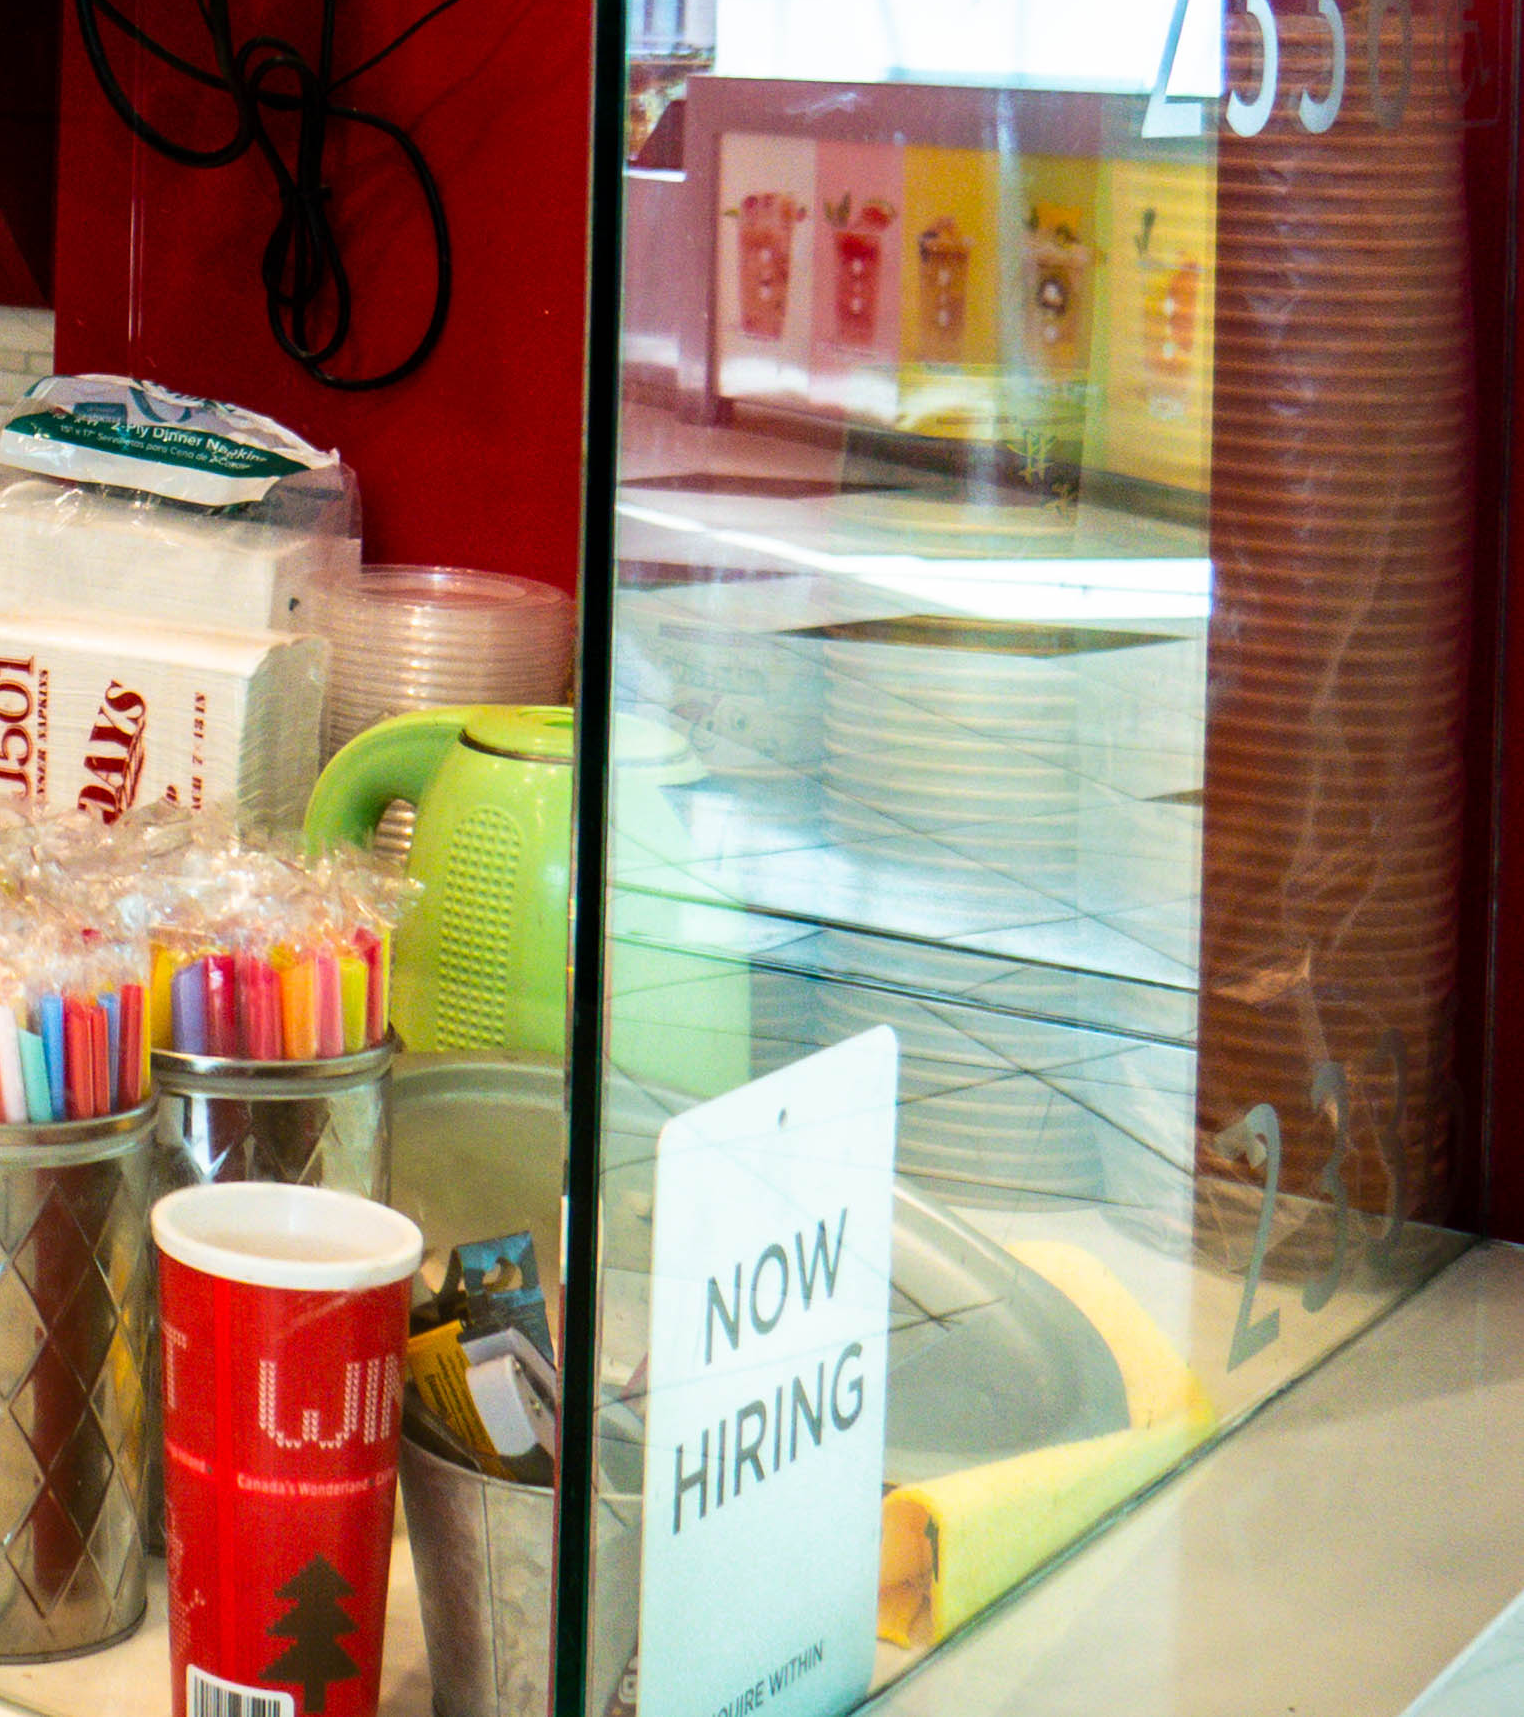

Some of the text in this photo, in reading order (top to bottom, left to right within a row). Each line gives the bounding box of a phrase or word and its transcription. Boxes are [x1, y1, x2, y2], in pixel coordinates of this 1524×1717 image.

[152, 427, 203, 449] Dinner
[35, 669, 50, 743] NAPKINS
[705, 1207, 848, 1366] NOW
[672, 1341, 864, 1536] HIRING
[237, 1473, 369, 1498] Canada's Wonderland
[768, 1638, 825, 1697] WITHIN
